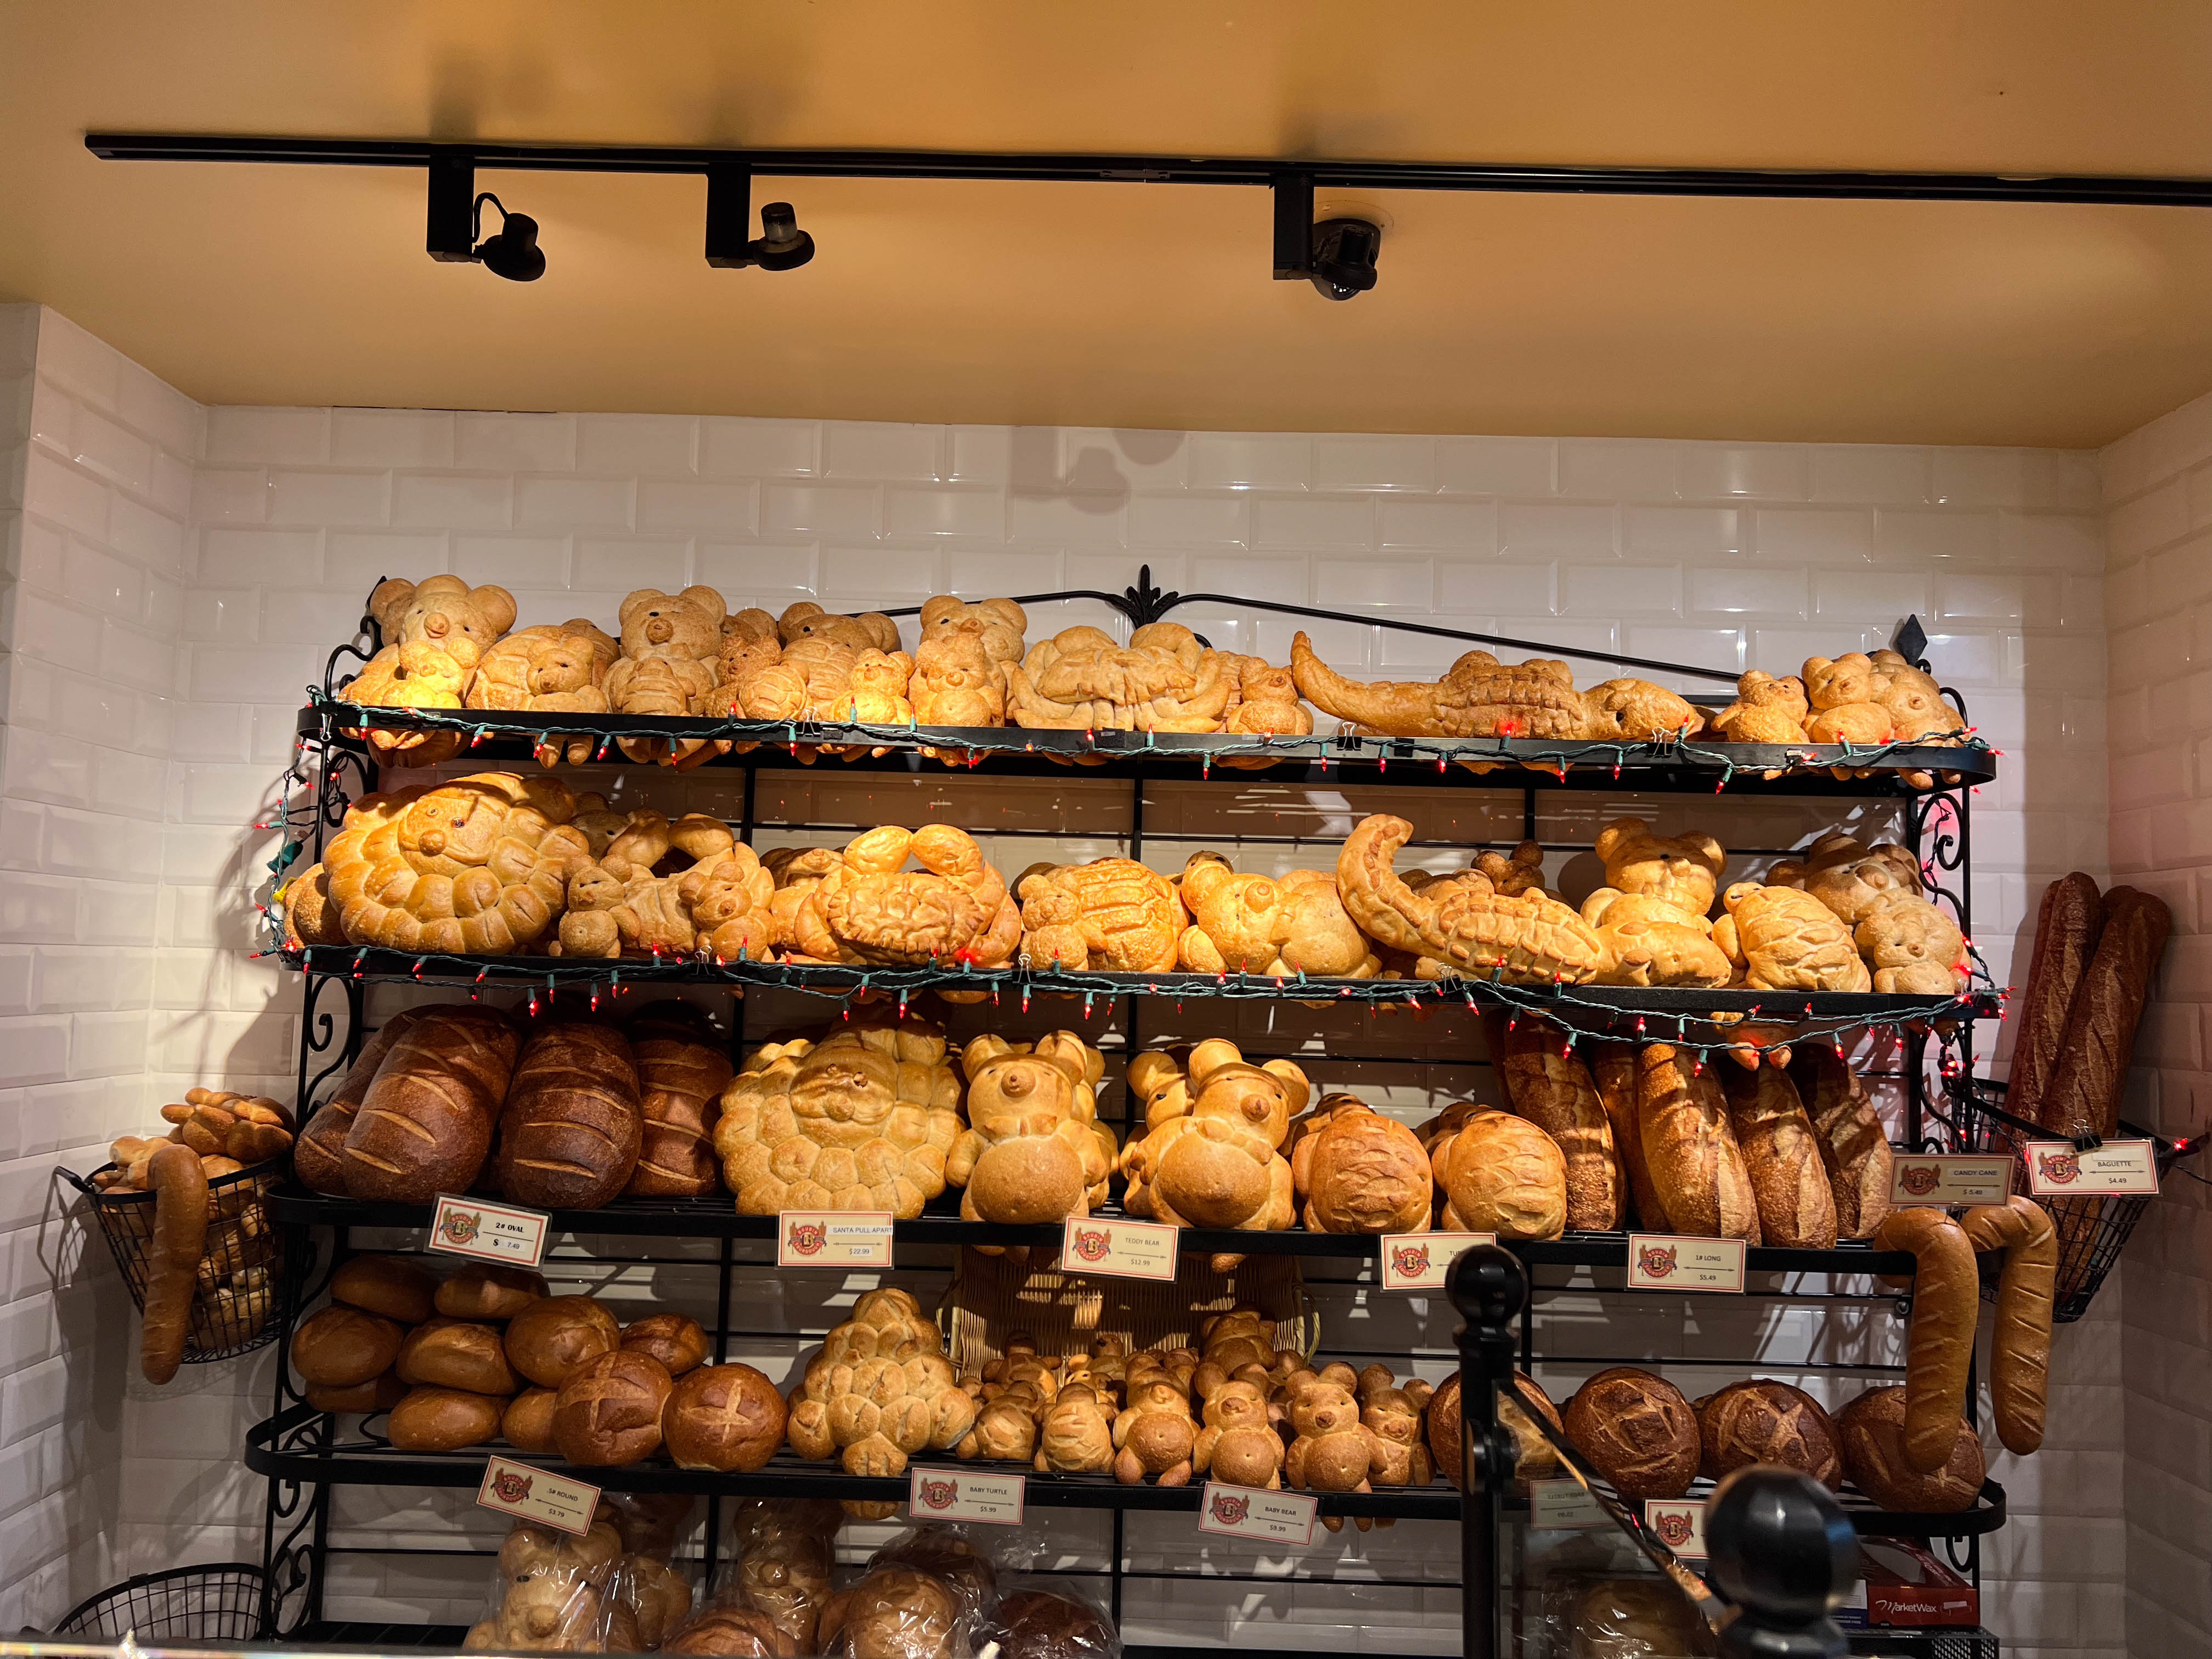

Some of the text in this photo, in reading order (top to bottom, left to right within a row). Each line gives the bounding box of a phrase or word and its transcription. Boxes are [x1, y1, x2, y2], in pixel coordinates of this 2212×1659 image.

[2046, 1171, 2074, 1182] SOURDOUGH
[452, 1215, 472, 1225] BOUDIN
[508, 1225, 524, 1233] OVAL
[798, 1226, 818, 1234] BOUDIN
[1083, 1233, 1103, 1242] BOUDIN
[794, 1242, 820, 1254] SOURDOUGH
[1401, 1249, 1421, 1257] BOUDIN
[1398, 1264, 1423, 1276] SOURDOUGH
[557, 1490, 578, 1502] ROUND
[549, 1509, 565, 1517] $3.79
[1875, 1600, 1937, 1614] MarketWax
